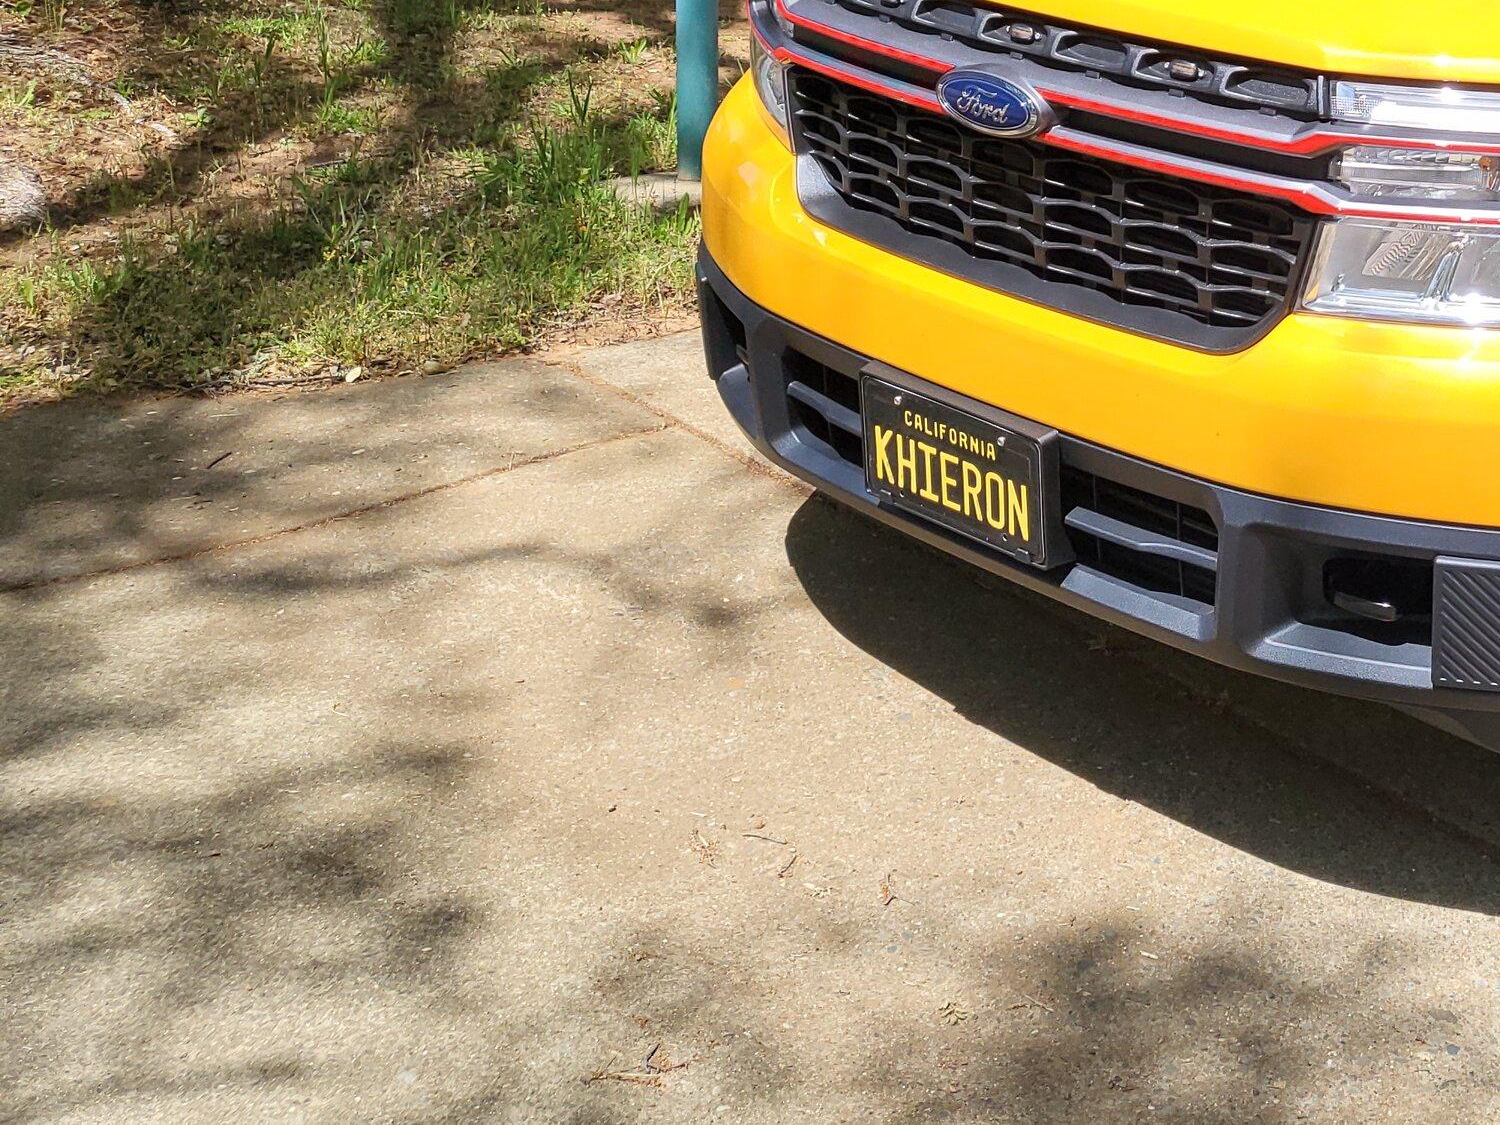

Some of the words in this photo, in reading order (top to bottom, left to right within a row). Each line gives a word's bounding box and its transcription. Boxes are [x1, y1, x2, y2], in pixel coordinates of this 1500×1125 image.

[957, 84, 1010, 124] Ford
[904, 410, 996, 461] CALIFORNIA
[874, 425, 1029, 542] KHIERON
